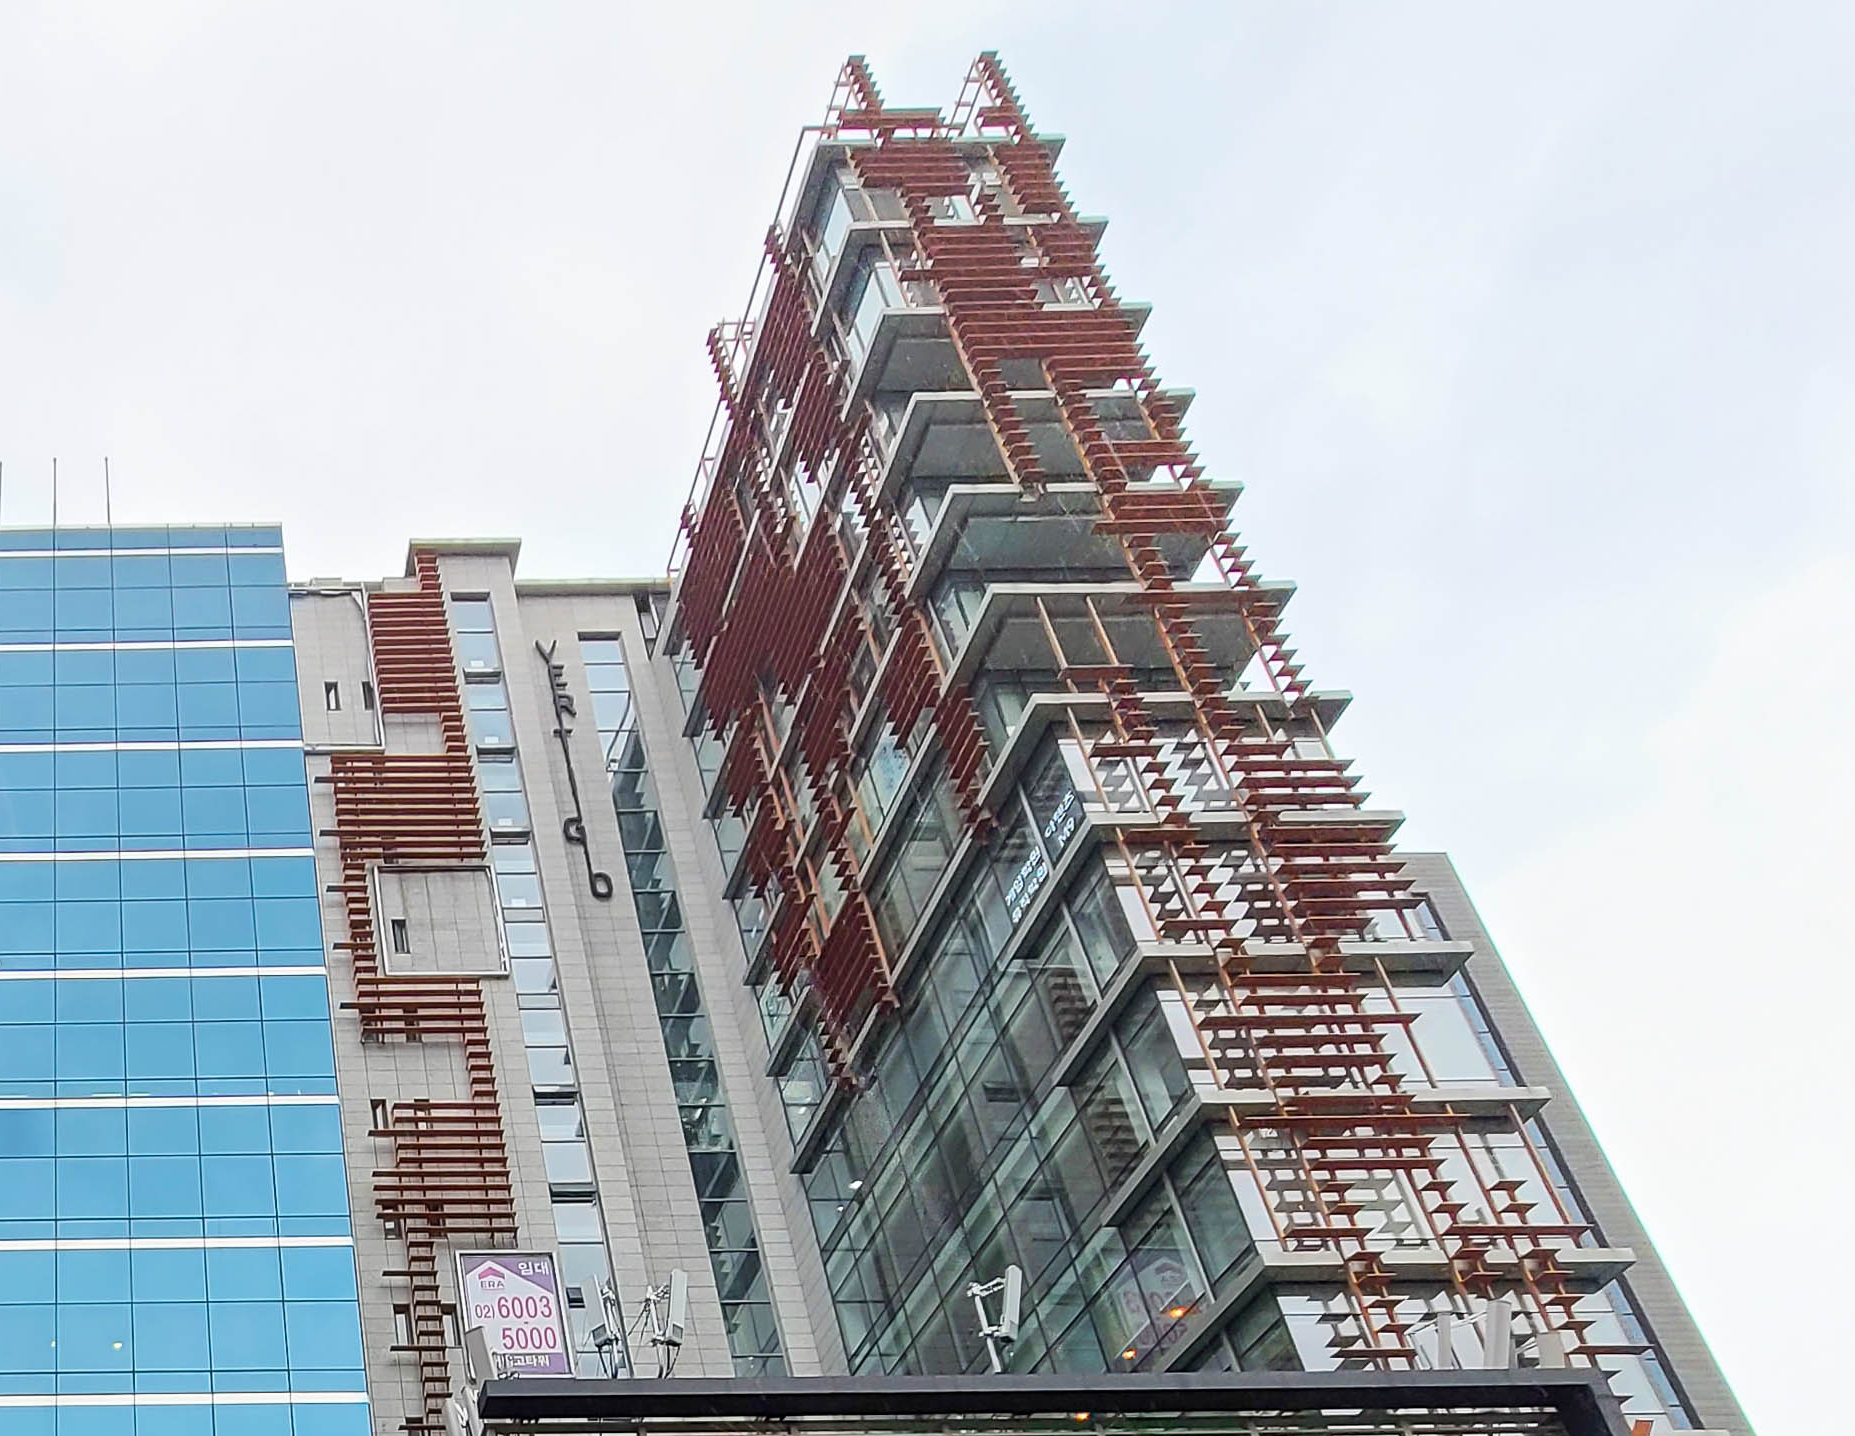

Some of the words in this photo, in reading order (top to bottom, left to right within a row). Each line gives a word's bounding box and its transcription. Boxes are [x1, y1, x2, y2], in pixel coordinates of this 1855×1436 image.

[518, 1261, 549, 1275] 임대
[480, 1280, 505, 1288] ERA
[474, 1304, 495, 1320] 02)
[497, 1296, 552, 1318] 6003
[502, 1327, 557, 1350] 5000
